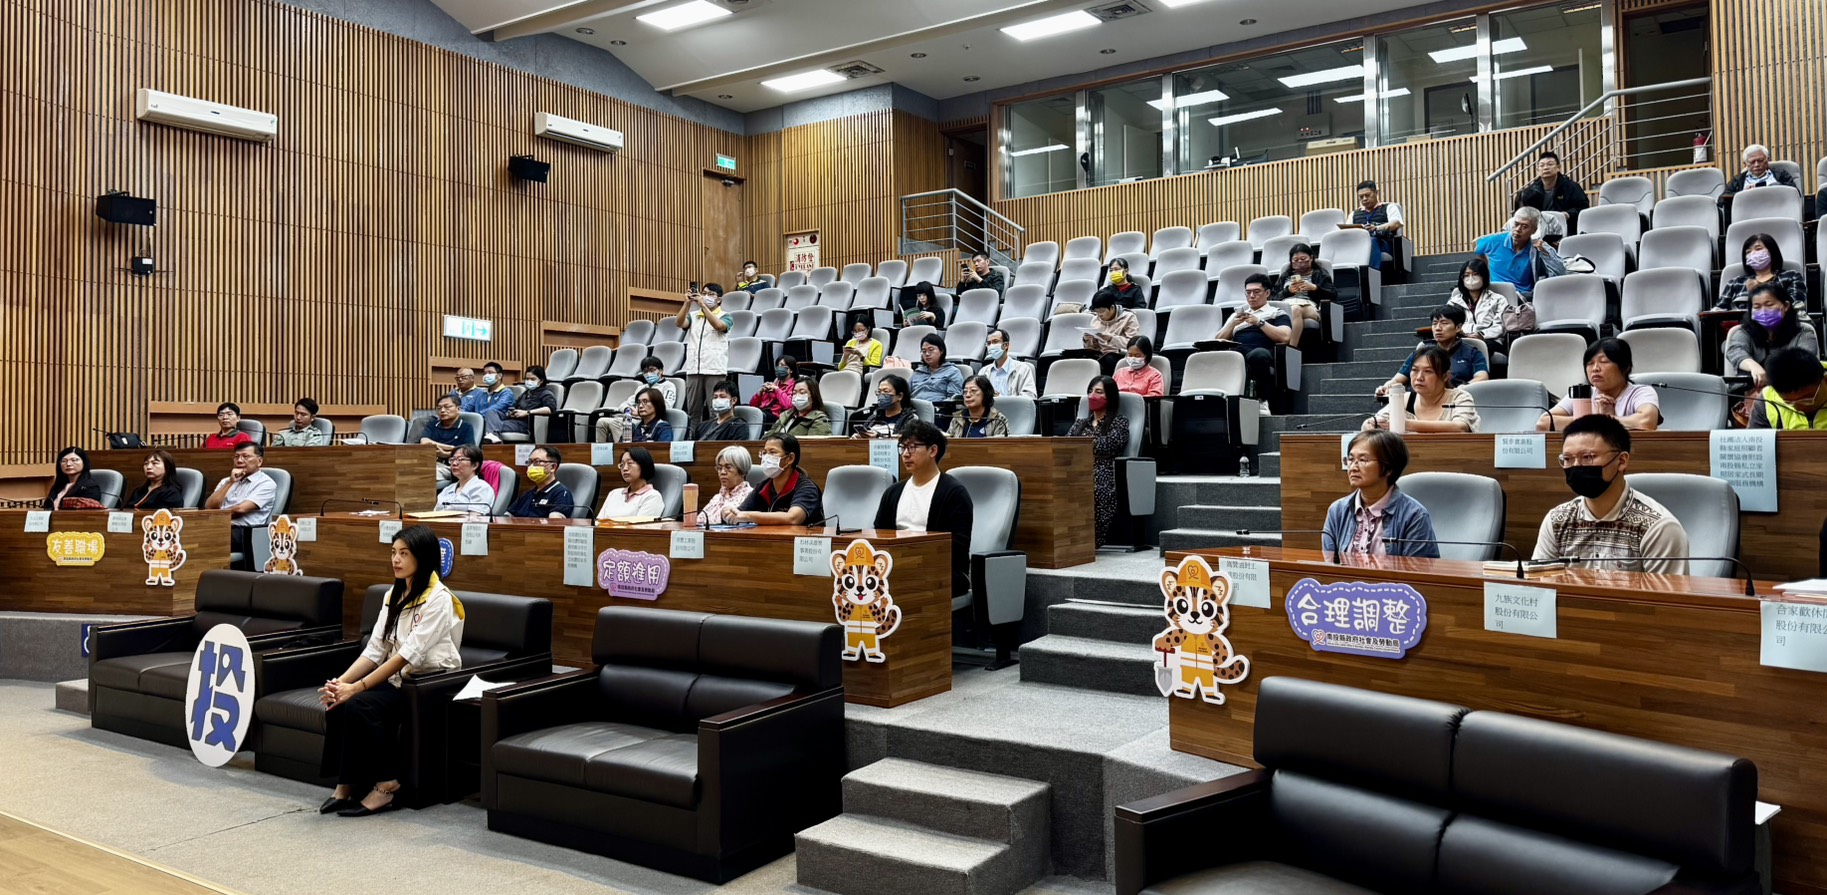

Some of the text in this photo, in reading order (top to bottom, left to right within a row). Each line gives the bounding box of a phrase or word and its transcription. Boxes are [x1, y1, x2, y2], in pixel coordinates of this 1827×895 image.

[795, 252, 814, 263] 消防栓
[52, 538, 99, 555] 友善職場
[602, 559, 661, 586] 定額進用
[1495, 593, 1539, 607] 九族文化村
[1297, 593, 1411, 635] 合理調整
[1495, 606, 1539, 620] 股份有限公
[1495, 620, 1504, 629] 司
[1326, 633, 1400, 648] 南投縣政府社會及勞動局
[1776, 635, 1786, 647] 司
[191, 640, 246, 753] 投
